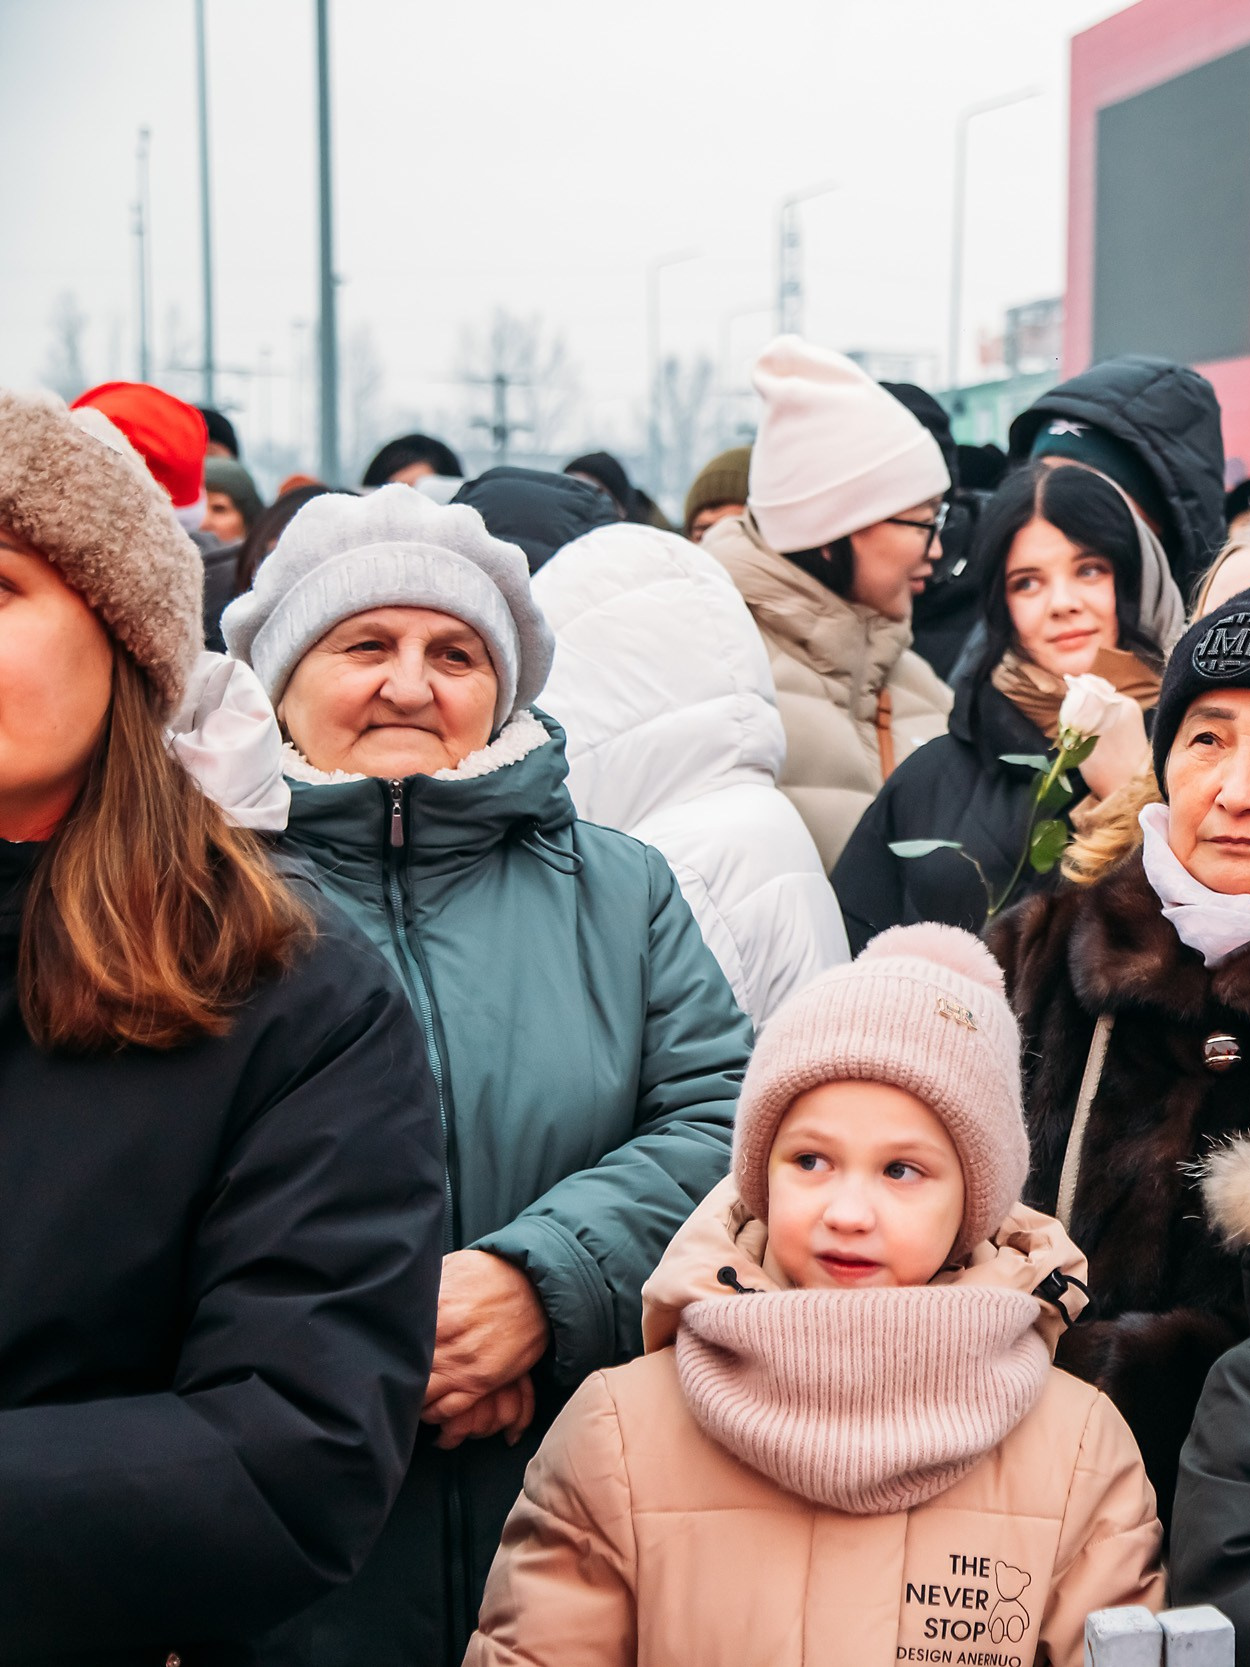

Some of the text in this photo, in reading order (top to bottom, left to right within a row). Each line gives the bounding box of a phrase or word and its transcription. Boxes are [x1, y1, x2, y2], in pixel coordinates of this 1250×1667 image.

[949, 1554, 991, 1579] THE
[905, 1583, 990, 1611] NEVER
[923, 1617, 986, 1643] STOP
[896, 1646, 952, 1664] DESIGN
